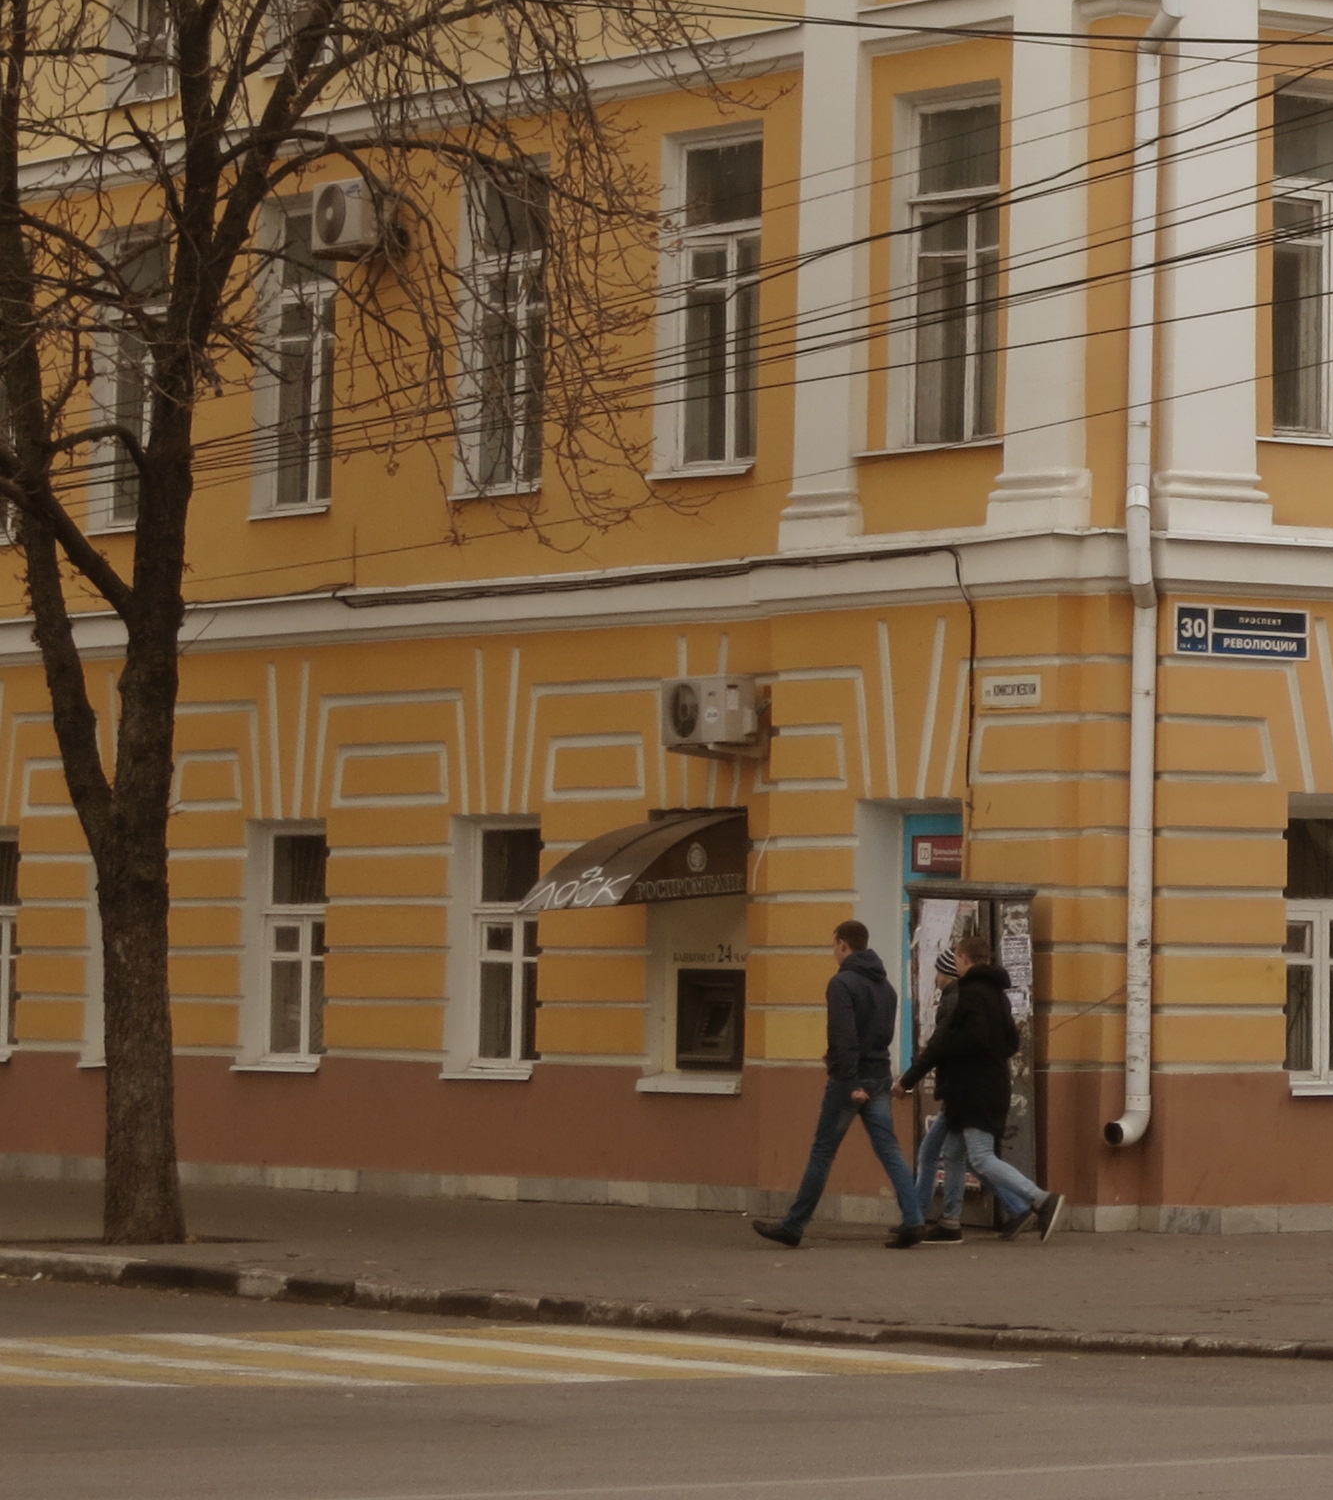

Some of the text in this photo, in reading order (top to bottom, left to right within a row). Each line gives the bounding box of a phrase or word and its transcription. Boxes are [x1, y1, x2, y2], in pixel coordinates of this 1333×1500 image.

[1180, 617, 1206, 639] 30
[1238, 616, 1282, 626] ПРОСПЕКТ
[1223, 637, 1298, 653] РЕВОЛЮЦИИ
[717, 943, 732, 963] 24
